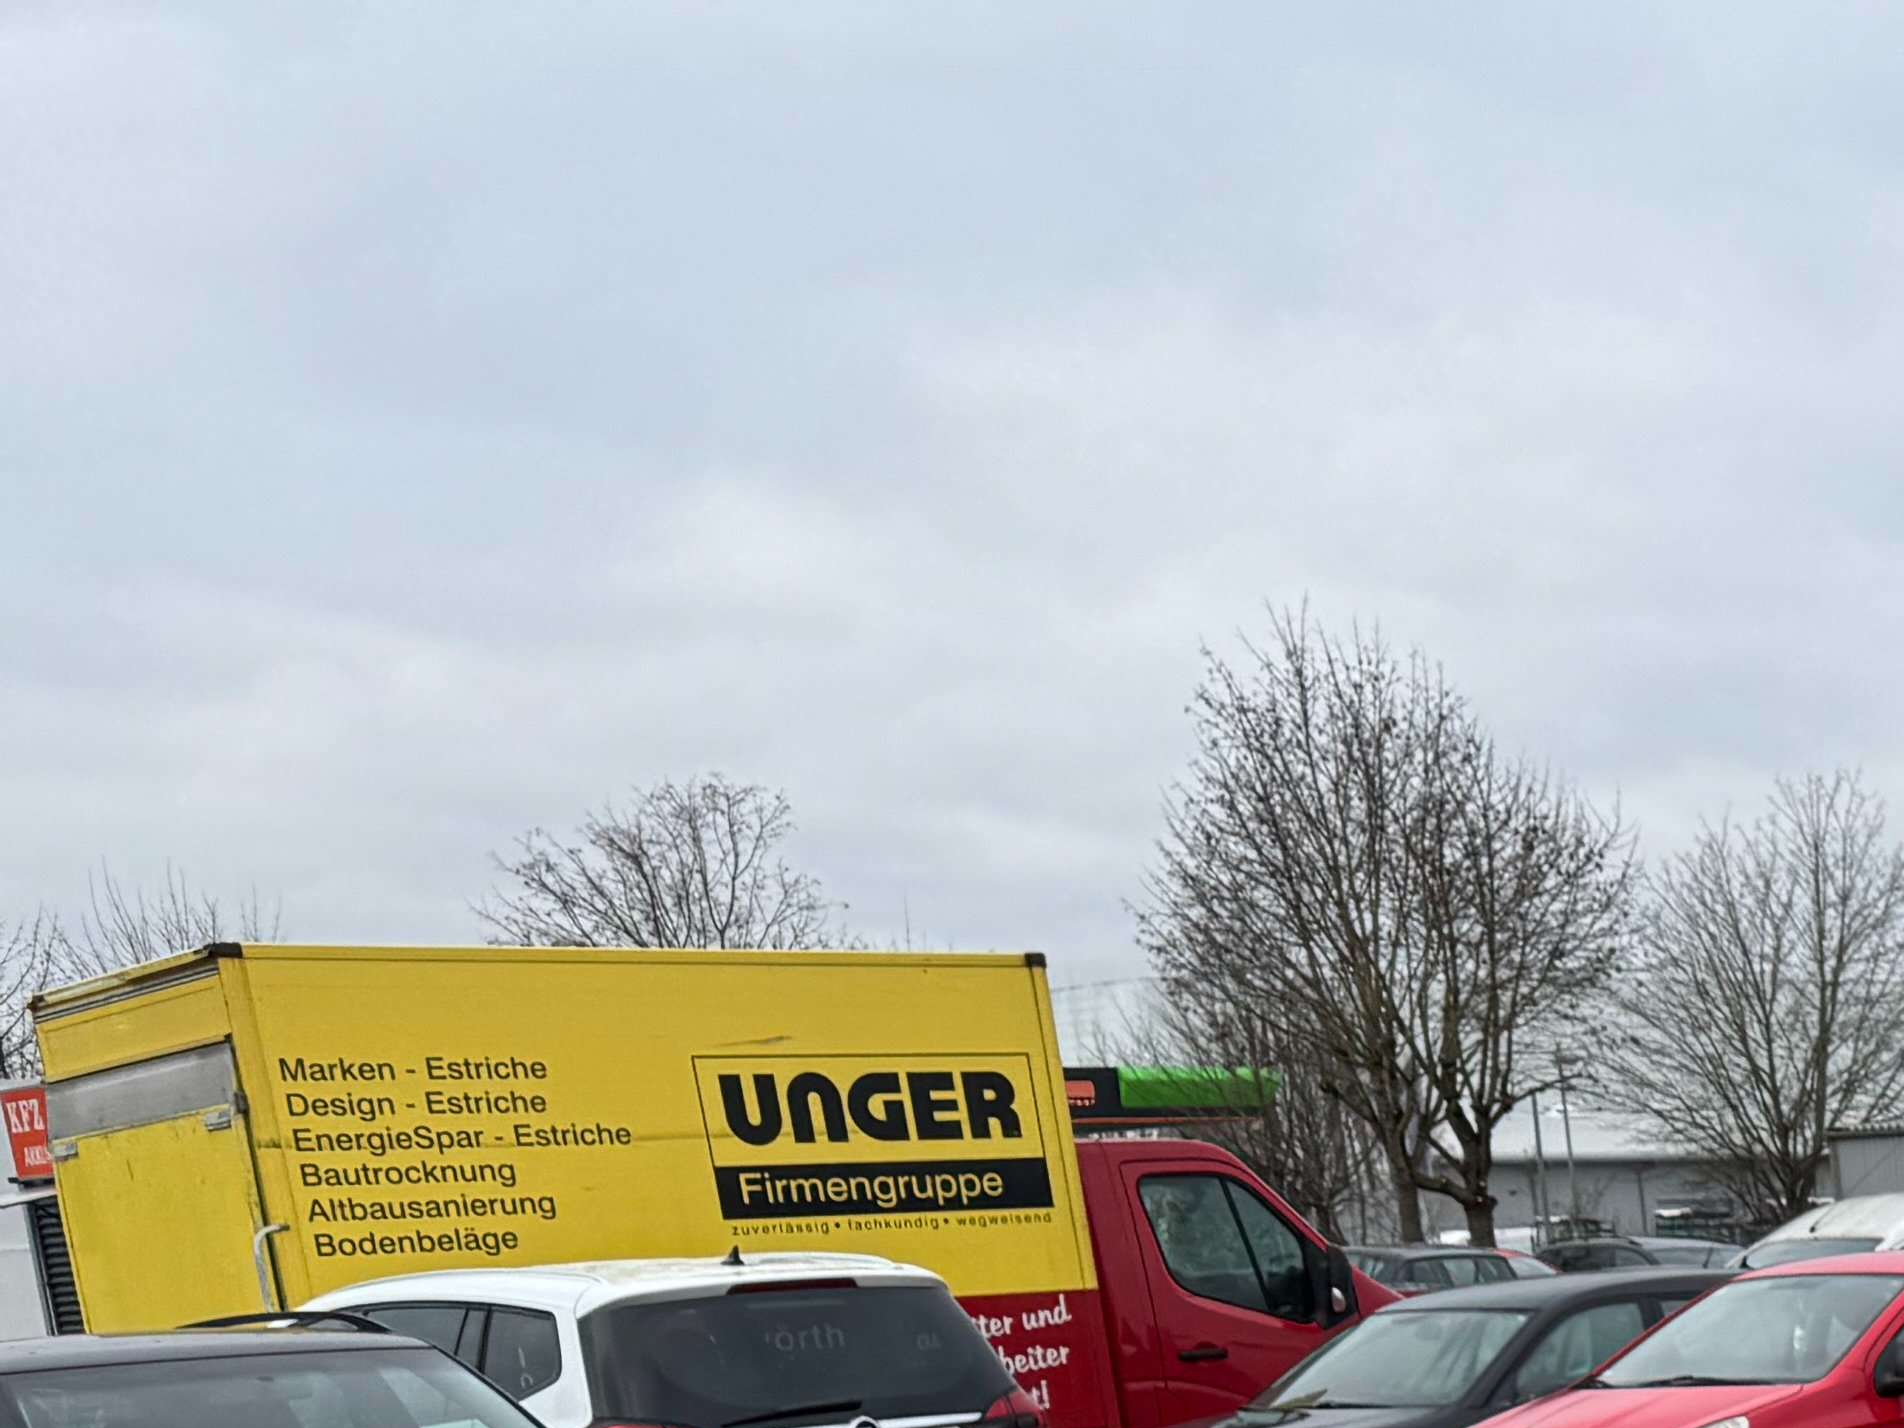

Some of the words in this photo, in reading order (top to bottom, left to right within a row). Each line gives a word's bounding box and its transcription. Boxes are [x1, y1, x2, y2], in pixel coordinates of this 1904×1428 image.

[279, 1058, 395, 1082] Marken
[426, 1056, 548, 1081] Estriche
[6, 1099, 45, 1134] KFZ
[285, 1093, 395, 1122] Design
[425, 1091, 547, 1115] Estriche
[717, 1071, 1023, 1146] UNGER
[292, 1126, 484, 1156] EnergieSpar
[513, 1123, 632, 1147] Estriche
[300, 1160, 517, 1188] Bautrocknung
[738, 1171, 1004, 1208] Firmengruppe
[308, 1194, 557, 1223] Altbausanierung
[730, 1220, 830, 1236] zuverlässig
[848, 1216, 940, 1231] fachkundig
[956, 1212, 1053, 1226] wegweisend
[313, 1227, 519, 1257] Bodenbeläge
[1022, 1293, 1072, 1331] und
